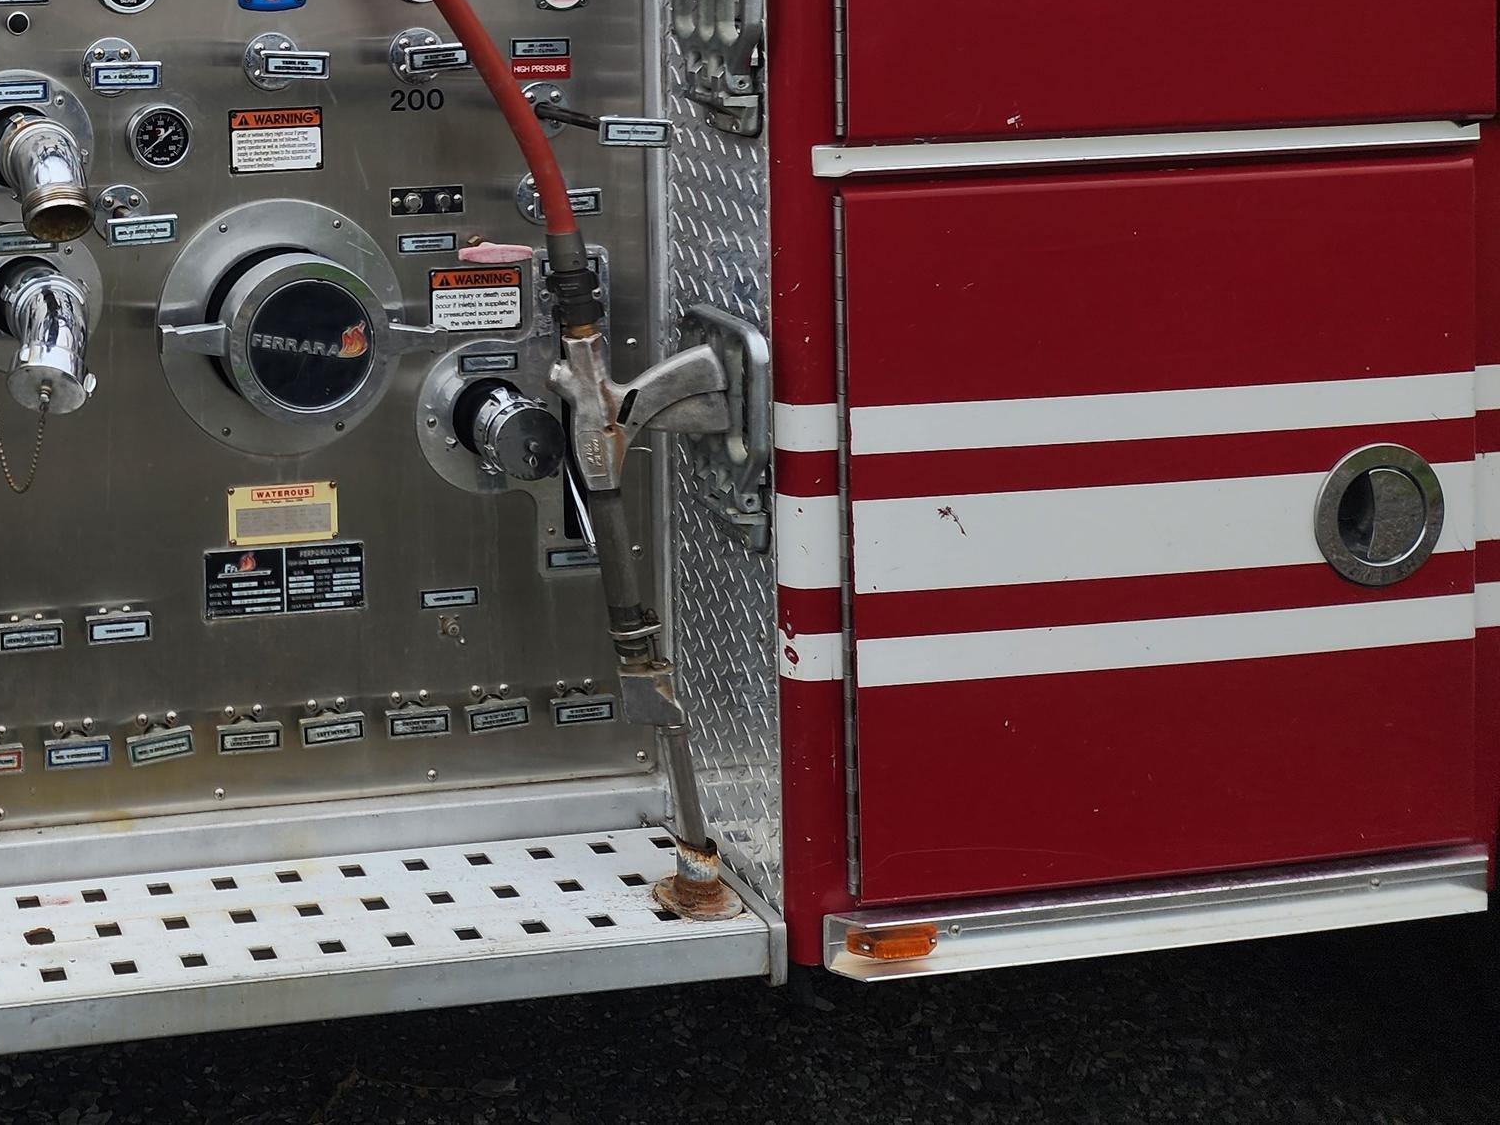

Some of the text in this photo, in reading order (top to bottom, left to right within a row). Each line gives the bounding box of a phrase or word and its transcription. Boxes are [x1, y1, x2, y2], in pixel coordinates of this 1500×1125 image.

[514, 64, 567, 73] HIGH PRESSURE
[390, 89, 444, 112] 200
[254, 113, 313, 125] WARNING
[454, 273, 512, 285] WARNING
[252, 333, 340, 356] FERRARA
[256, 488, 310, 499] WATEROUS
